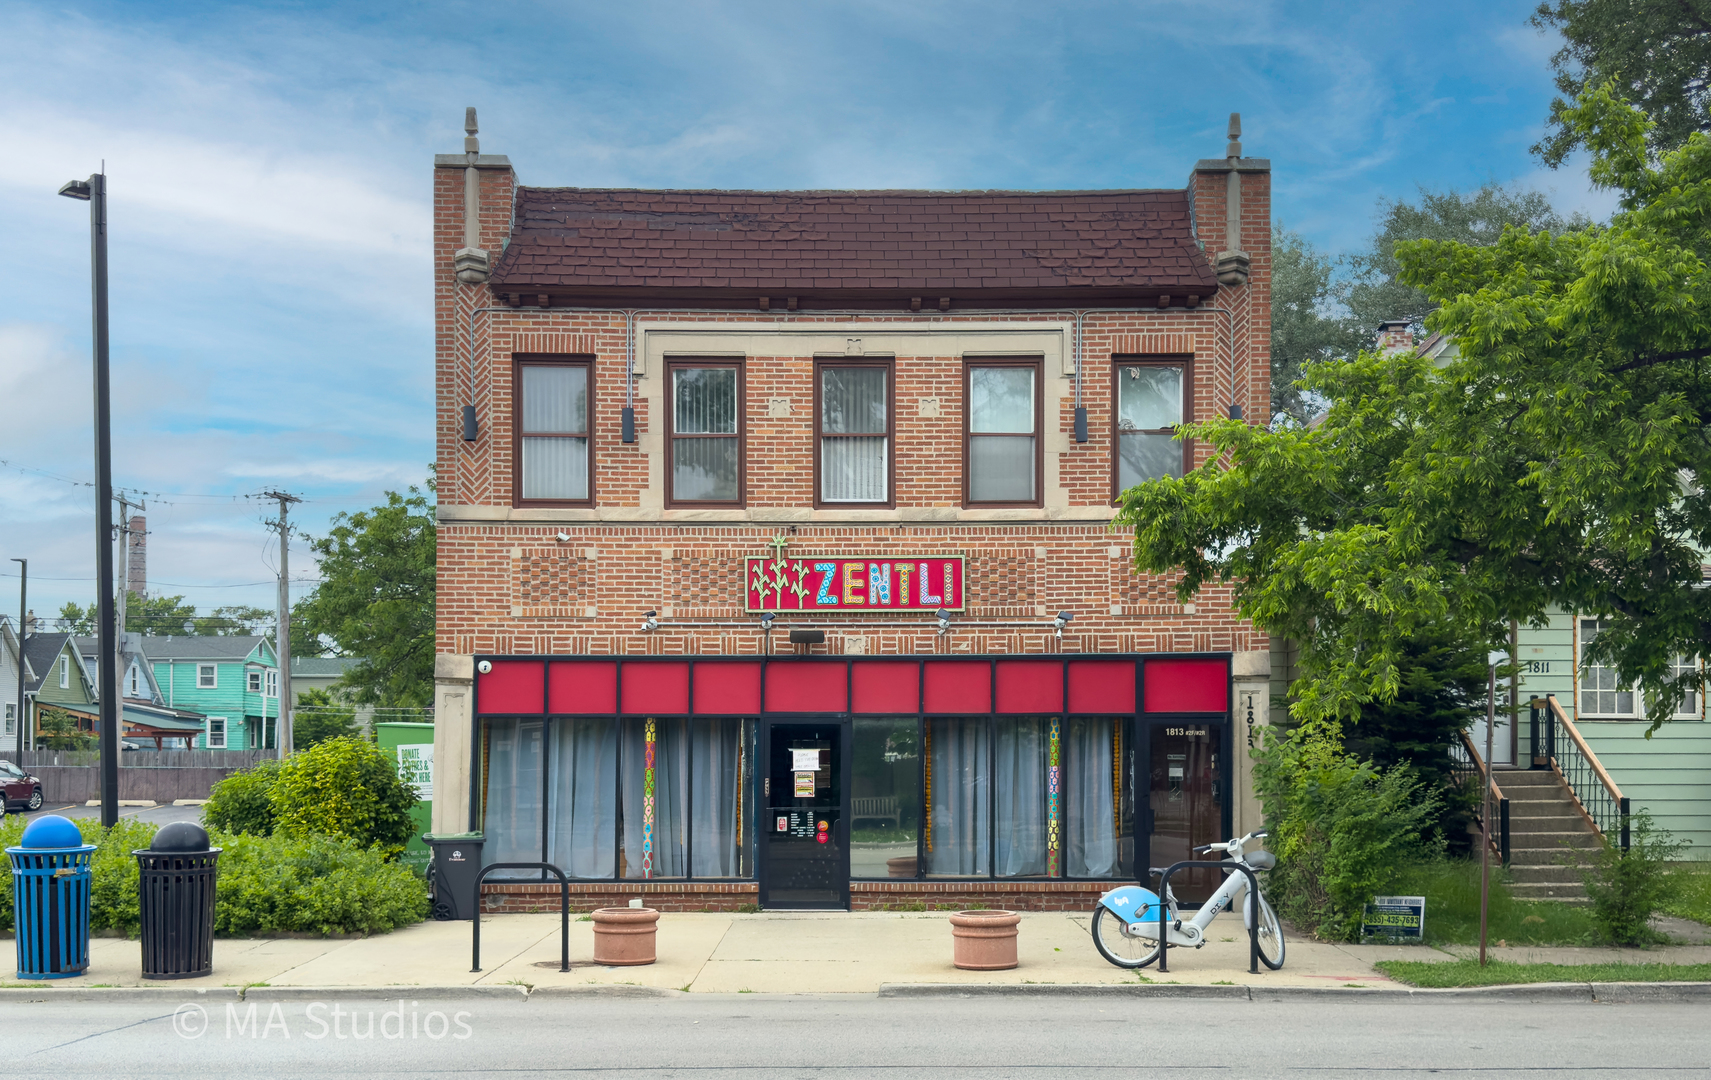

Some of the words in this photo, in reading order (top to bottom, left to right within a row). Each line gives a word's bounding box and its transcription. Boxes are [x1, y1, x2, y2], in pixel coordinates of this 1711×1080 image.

[814, 562, 954, 605] ZENTLI
[1529, 661, 1550, 673] 1811
[1165, 727, 1184, 736] 1813
[401, 748, 420, 760] DONATE
[423, 760, 430, 771] &
[418, 772, 431, 783] HERE
